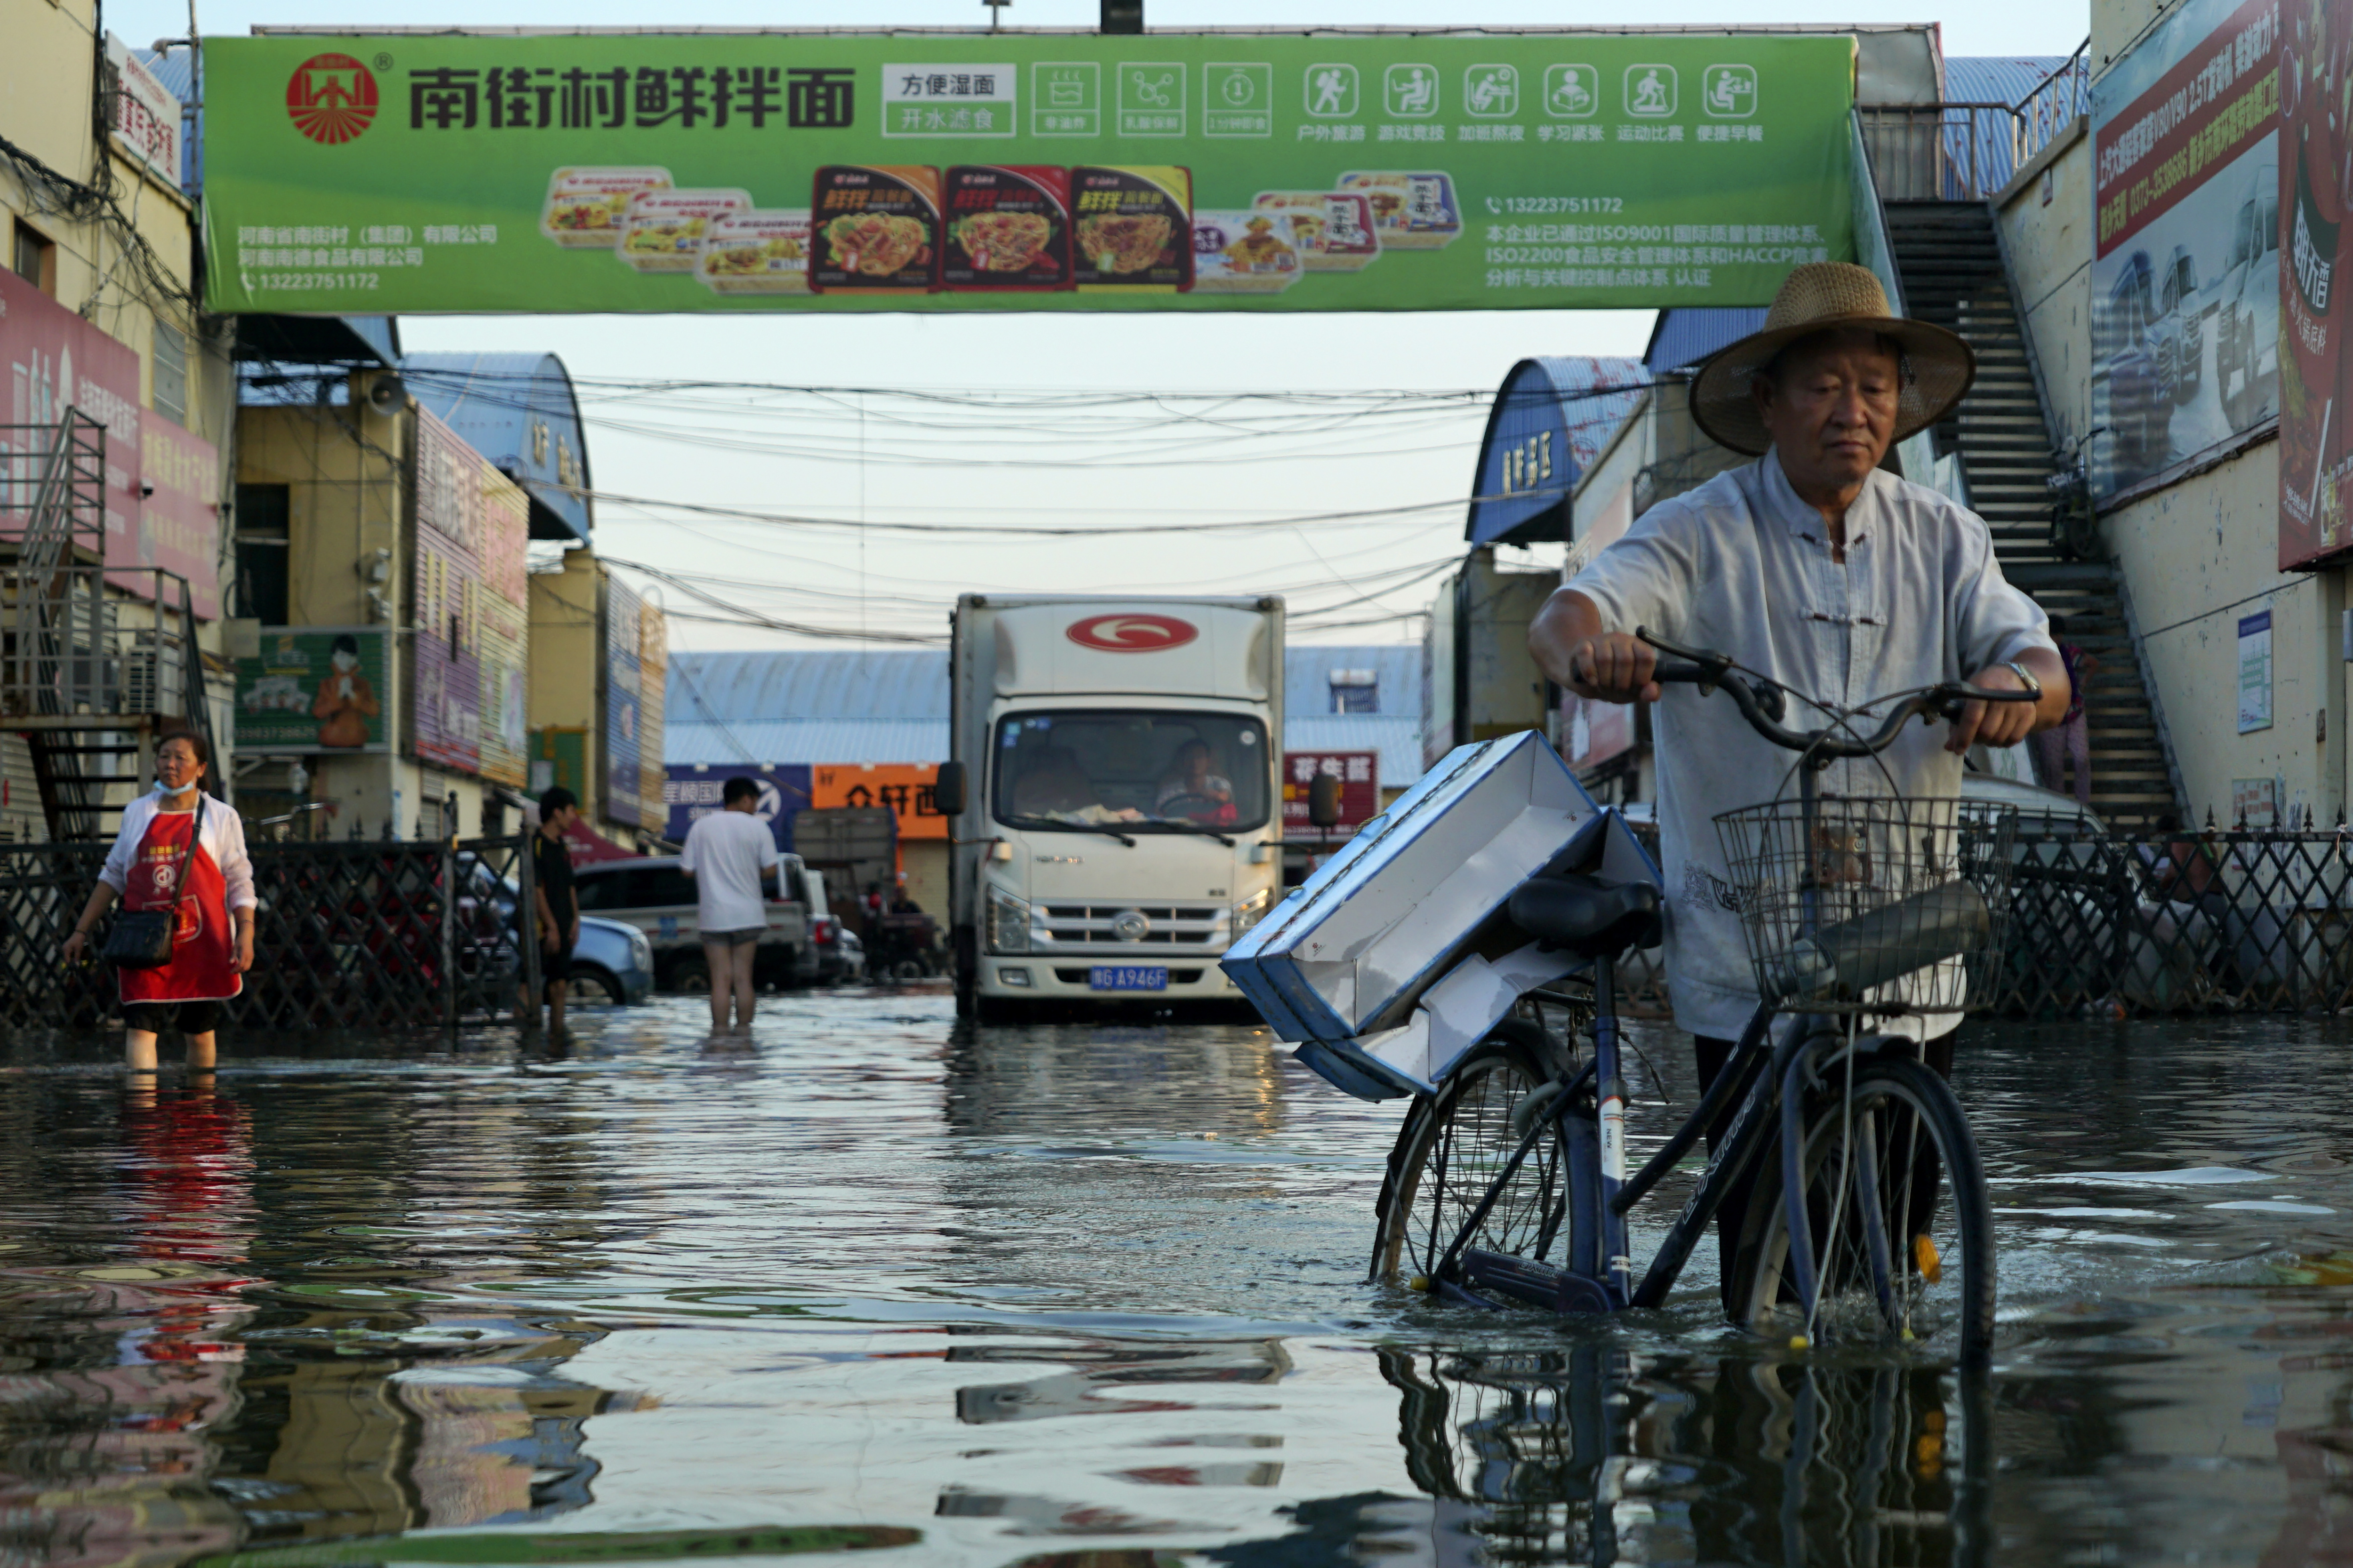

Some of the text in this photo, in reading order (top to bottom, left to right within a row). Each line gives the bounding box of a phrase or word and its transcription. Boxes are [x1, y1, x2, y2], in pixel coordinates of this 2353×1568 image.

[902, 74, 996, 96] 方便湿面
[409, 67, 856, 129] 南街村鲜拌面
[901, 107, 995, 130] 开水滤食
[1297, 124, 1366, 142] 户外旅游
[1377, 124, 1445, 142] 游戏竞技
[1457, 124, 1525, 142] 加班熬夜
[1537, 124, 1605, 142] 学习紧张
[1617, 124, 1685, 142] 运动比赛
[1696, 124, 1763, 142] 便捷早餐
[1506, 197, 1623, 213] 13223751172
[260, 273, 379, 289] 13223751172
[1676, 268, 1711, 287] 认证
